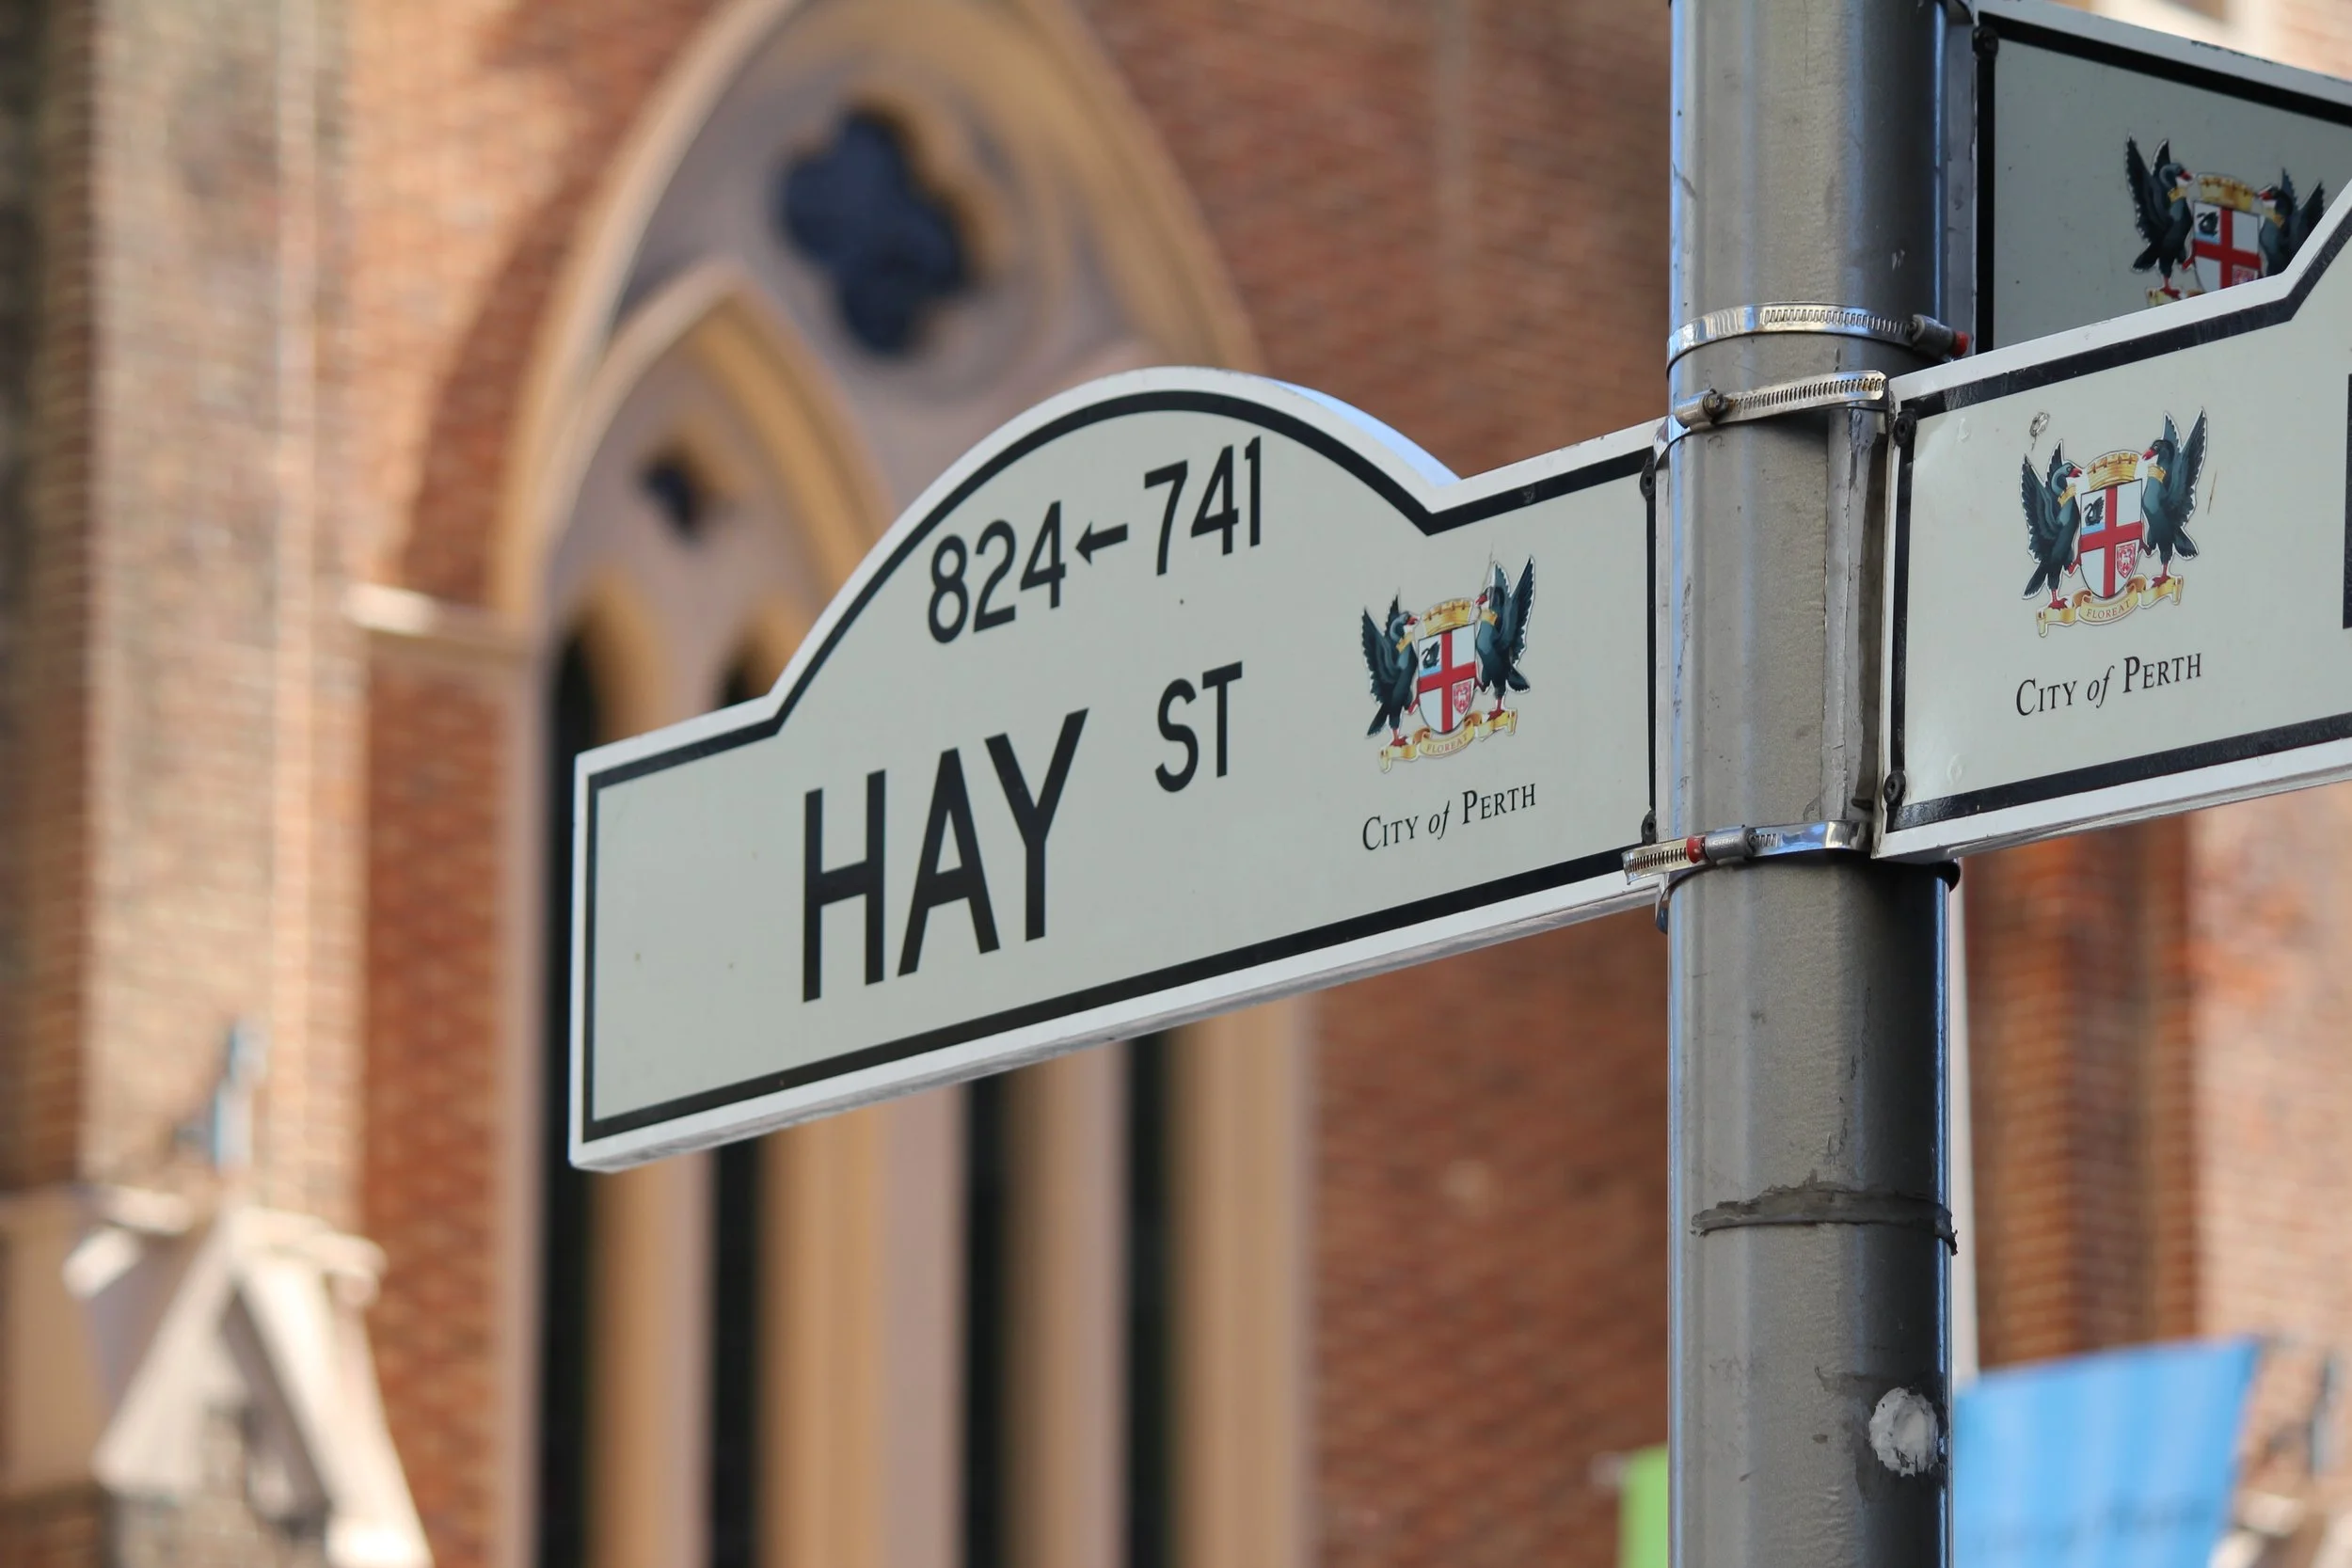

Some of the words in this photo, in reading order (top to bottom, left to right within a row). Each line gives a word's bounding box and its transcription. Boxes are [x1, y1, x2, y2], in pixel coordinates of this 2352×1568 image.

[927, 499, 1067, 644] 824
[1144, 436, 1262, 577] 741
[2086, 598, 2132, 620] FLOREAT
[2087, 665, 2115, 708] of
[1425, 733, 1469, 754] FLOREAT
[802, 707, 1090, 1004] HAY
[1154, 660, 1243, 793] ST
[1428, 800, 1451, 840] of
